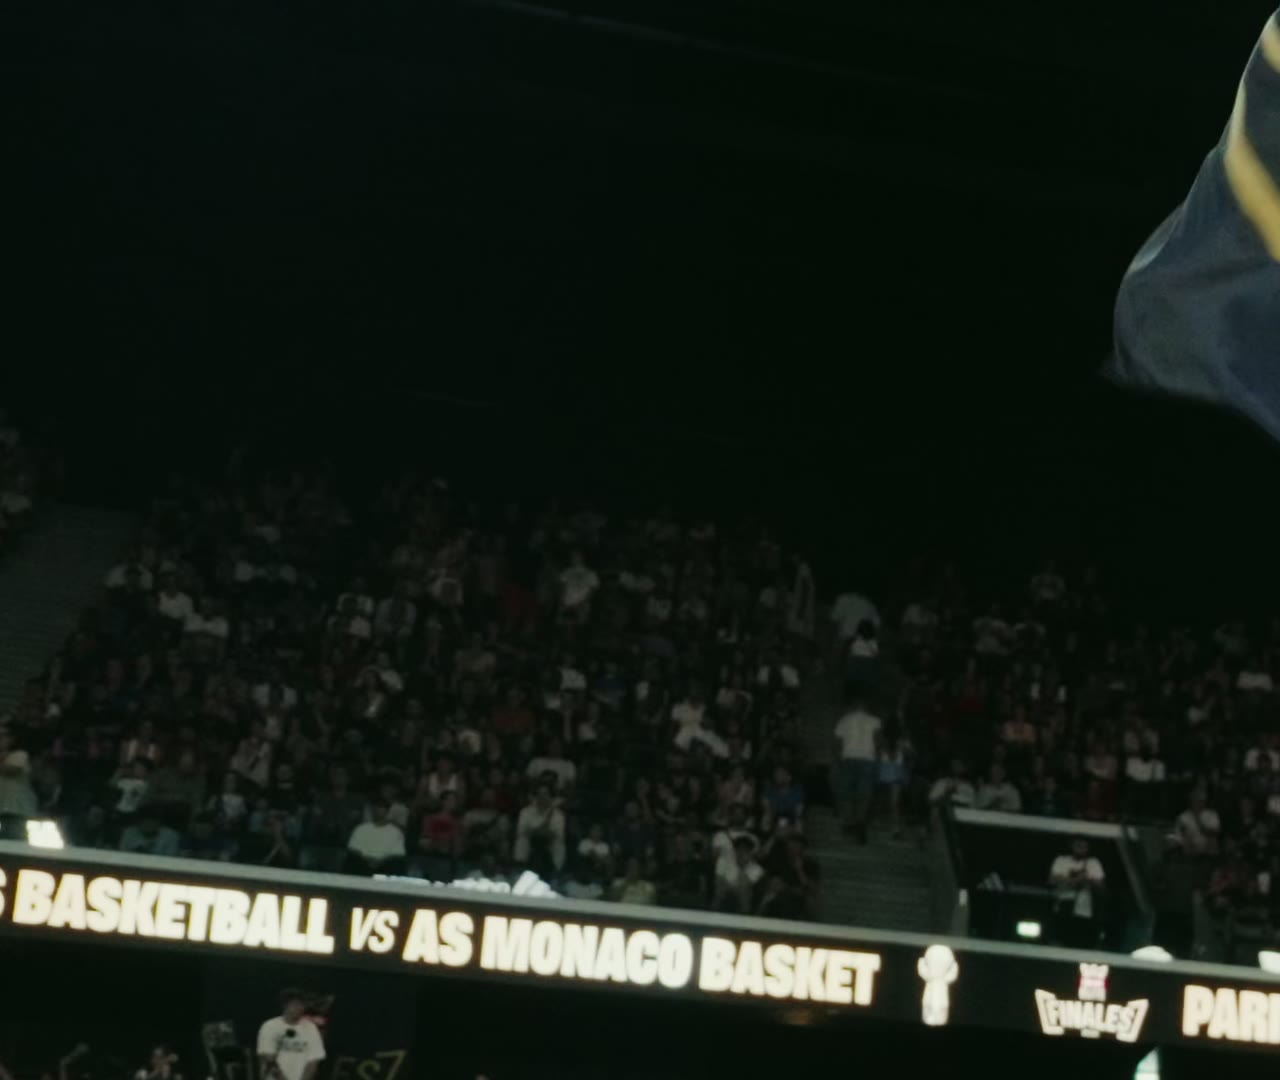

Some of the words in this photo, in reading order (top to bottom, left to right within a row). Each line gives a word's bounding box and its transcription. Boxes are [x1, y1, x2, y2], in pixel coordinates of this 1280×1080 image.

[16, 869, 334, 953] BASKETBALL
[350, 908, 399, 952] VS
[403, 909, 474, 966] AS
[480, 916, 692, 988] MONACO
[699, 937, 880, 1005] BASKET
